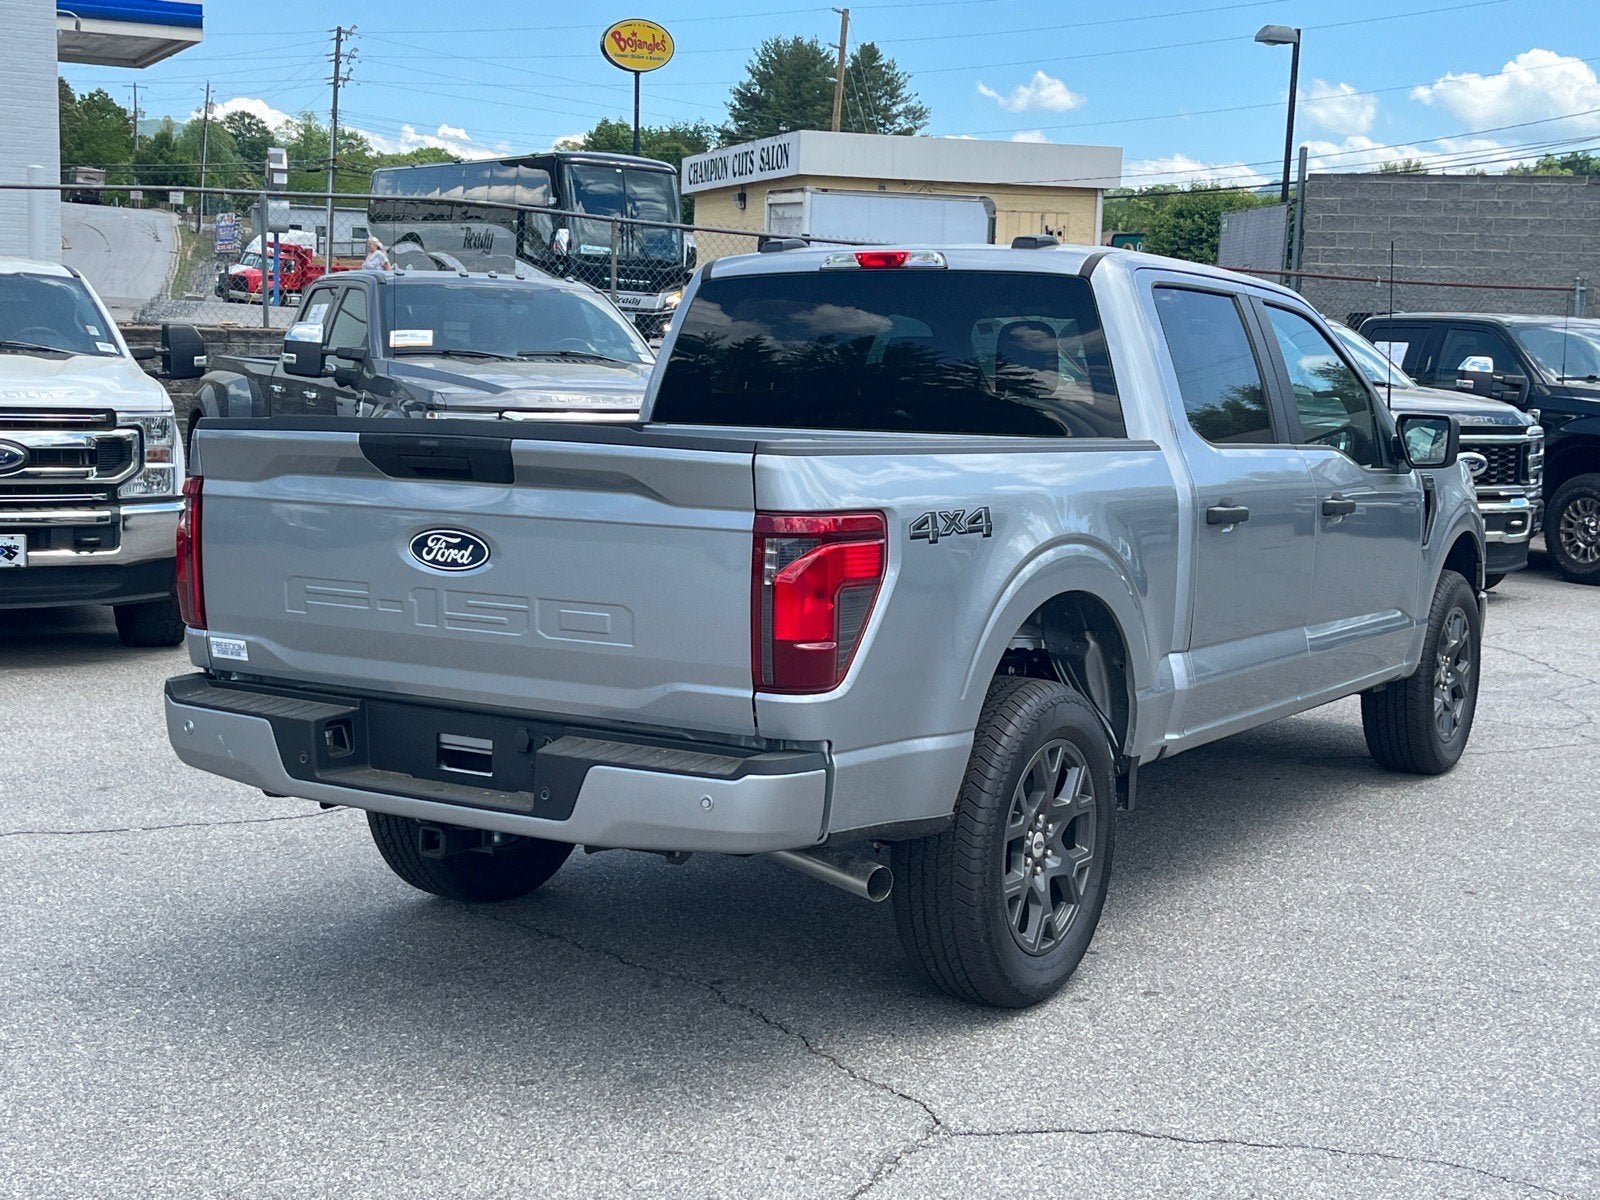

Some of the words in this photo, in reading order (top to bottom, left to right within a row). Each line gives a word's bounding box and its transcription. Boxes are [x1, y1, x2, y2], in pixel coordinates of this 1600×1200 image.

[688, 155, 729, 186] CHAMPION
[732, 149, 755, 178] CUTS
[759, 142, 790, 173] SALON
[461, 226, 495, 255] Ready
[422, 534, 474, 564] Ford
[284, 575, 635, 649] F-150
